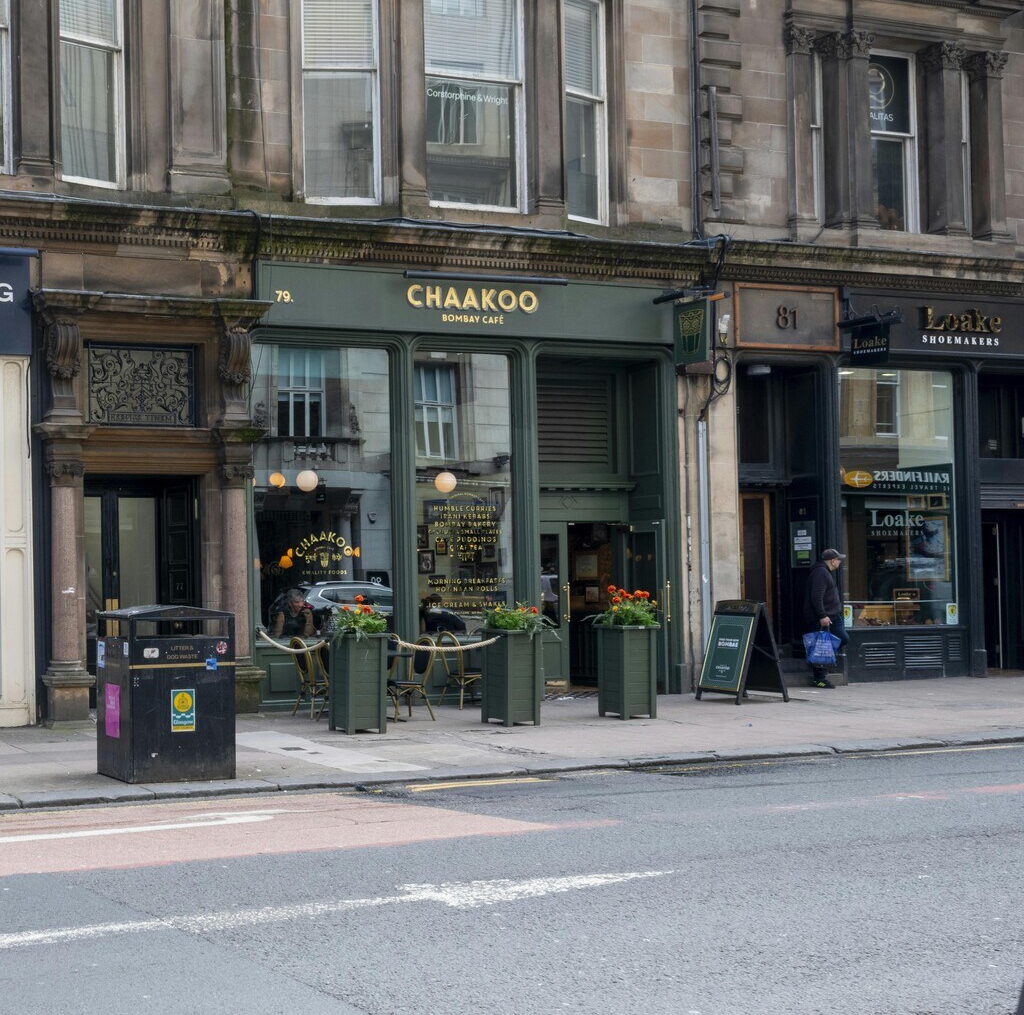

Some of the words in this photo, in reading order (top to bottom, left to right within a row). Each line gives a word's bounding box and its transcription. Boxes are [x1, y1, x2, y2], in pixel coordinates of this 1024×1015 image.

[427, 89, 476, 101] Corstorphine
[477, 94, 483, 102] &
[483, 96, 508, 105] Wright
[407, 284, 539, 313] CHAAKOO
[442, 314, 480, 324] BOMBAY
[482, 314, 505, 325] CAFÉ
[776, 305, 800, 329] 81
[924, 306, 1002, 333] Loake
[853, 336, 887, 349] Loake
[922, 335, 1000, 346] SHOEMAKERS
[853, 347, 887, 355] SHOEMAKERS
[870, 510, 925, 527] Loake
[296, 530, 353, 557] CHAAKOO
